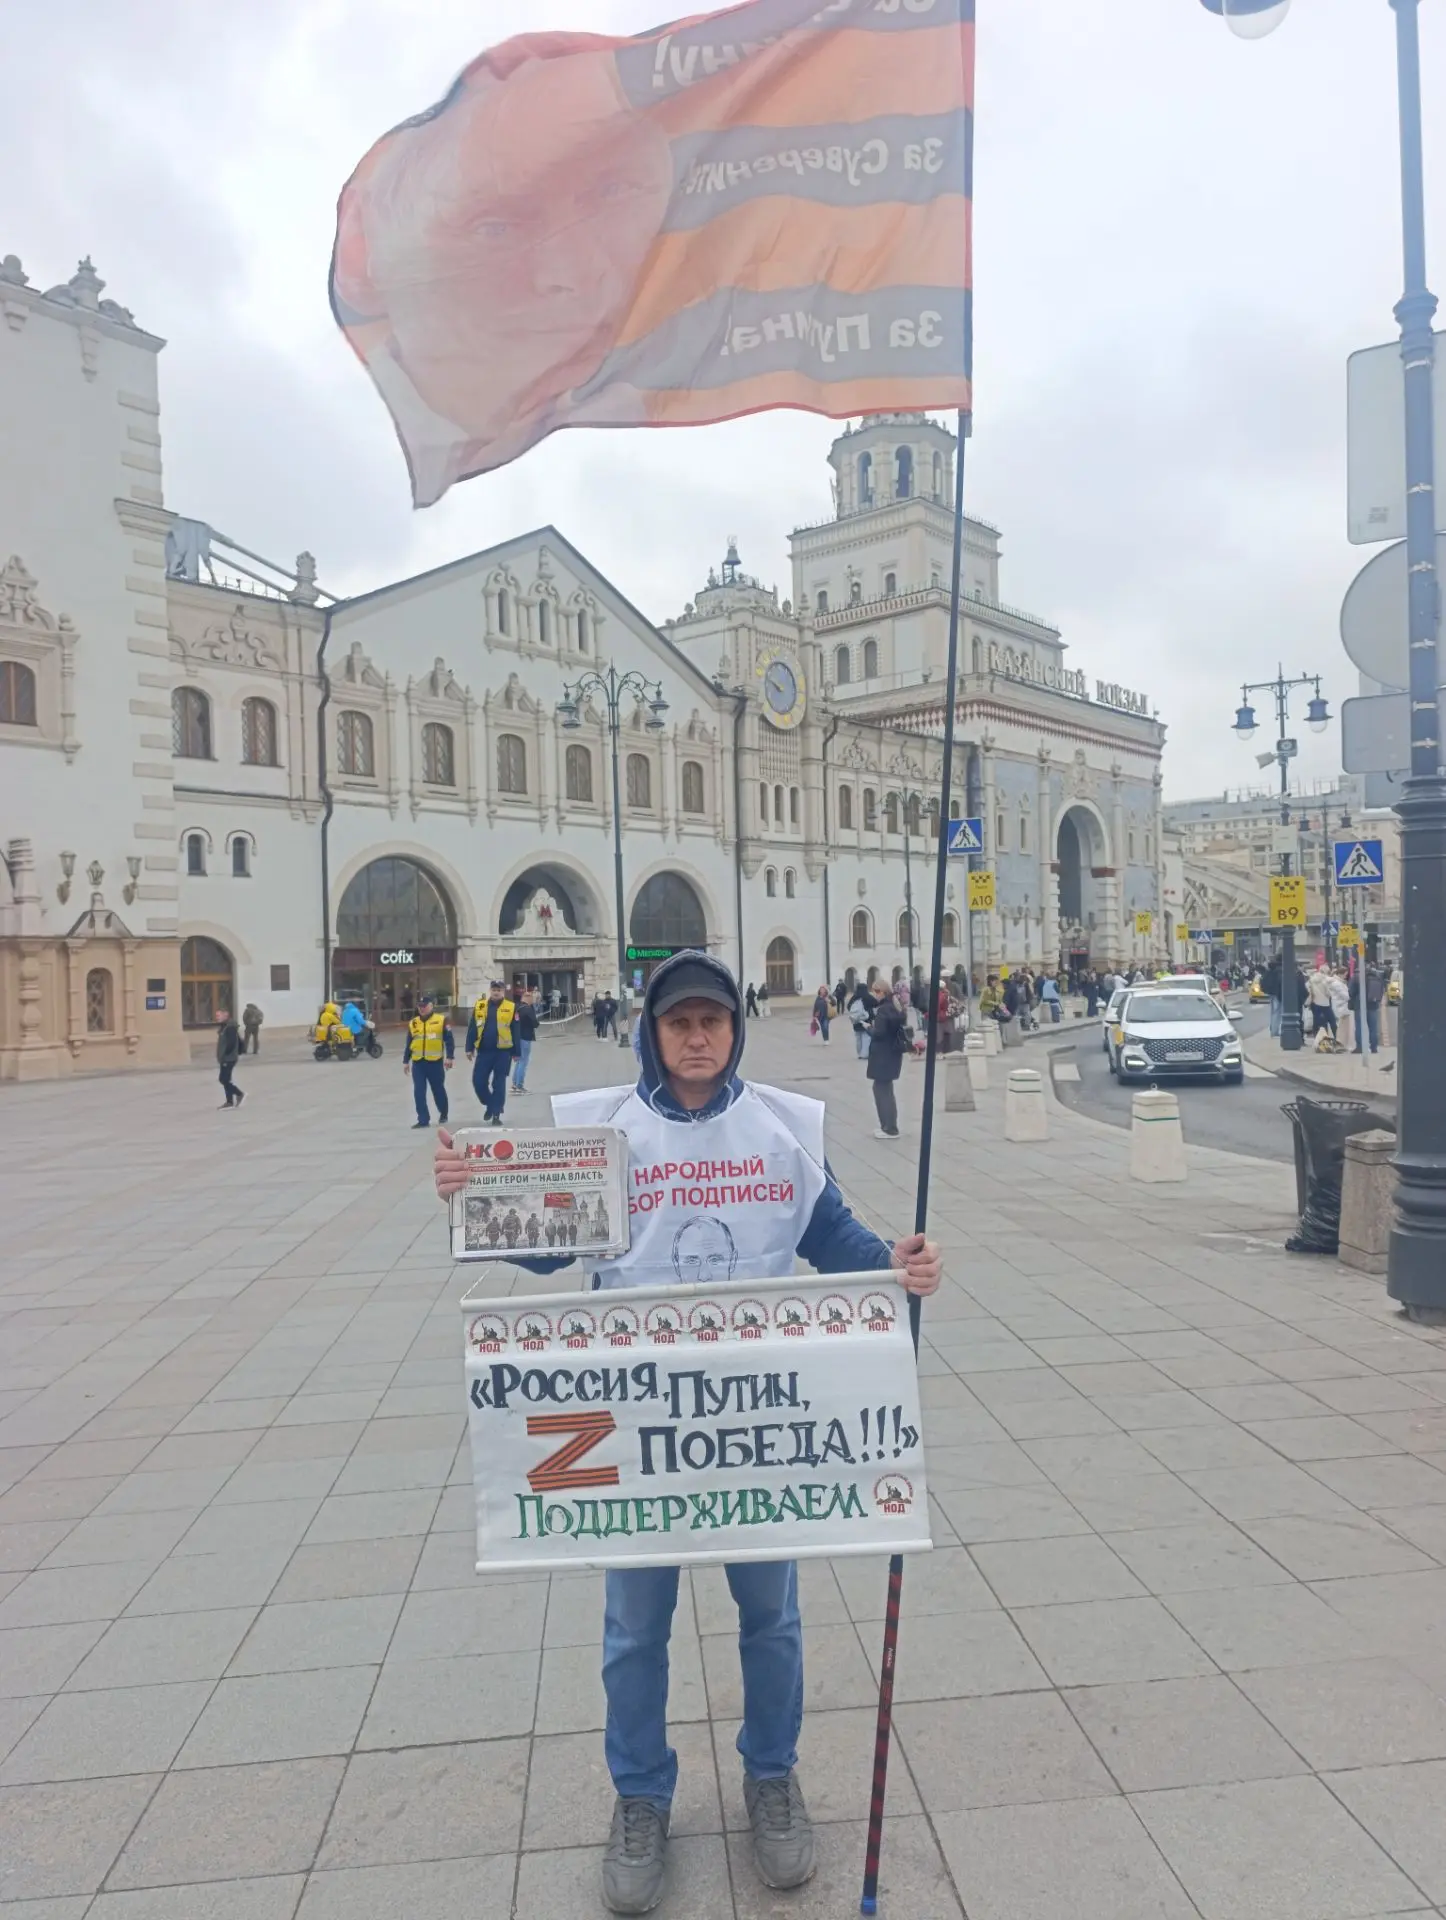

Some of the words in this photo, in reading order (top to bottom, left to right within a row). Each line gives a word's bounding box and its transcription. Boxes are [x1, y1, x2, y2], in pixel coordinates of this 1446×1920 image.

[989, 641, 1086, 695] КАЗАНСКИЙ
[1096, 680, 1148, 714] ВОКЗАЛ
[380, 950, 414, 964] cofix
[517, 1138, 585, 1149] НАЦИОНАЛЬНЫЙ
[586, 1138, 607, 1146] КУРС
[517, 1147, 607, 1160] СУВЕРЕНИТЕТ
[634, 1155, 765, 1186] НАРОДНЫЙ
[470, 1175, 497, 1186] НАШИ
[500, 1175, 529, 1184] ГЕРОИ
[539, 1173, 566, 1182] НАША
[569, 1171, 603, 1181] ВЛАСТЬ
[628, 1190, 665, 1214] БОР
[671, 1179, 794, 1208] ПОДПИСЕЙ
[784, 1326, 805, 1336] НОД
[826, 1324, 847, 1334] НОД
[869, 1322, 890, 1332] НОД
[654, 1334, 675, 1344] НОД
[697, 1332, 718, 1341] НОД
[740, 1329, 762, 1339] НОД
[523, 1341, 544, 1351] НОД
[567, 1338, 588, 1349] НОД
[610, 1336, 632, 1346] НОД
[479, 1344, 500, 1353] НОД
[884, 1503, 905, 1514] НОД
